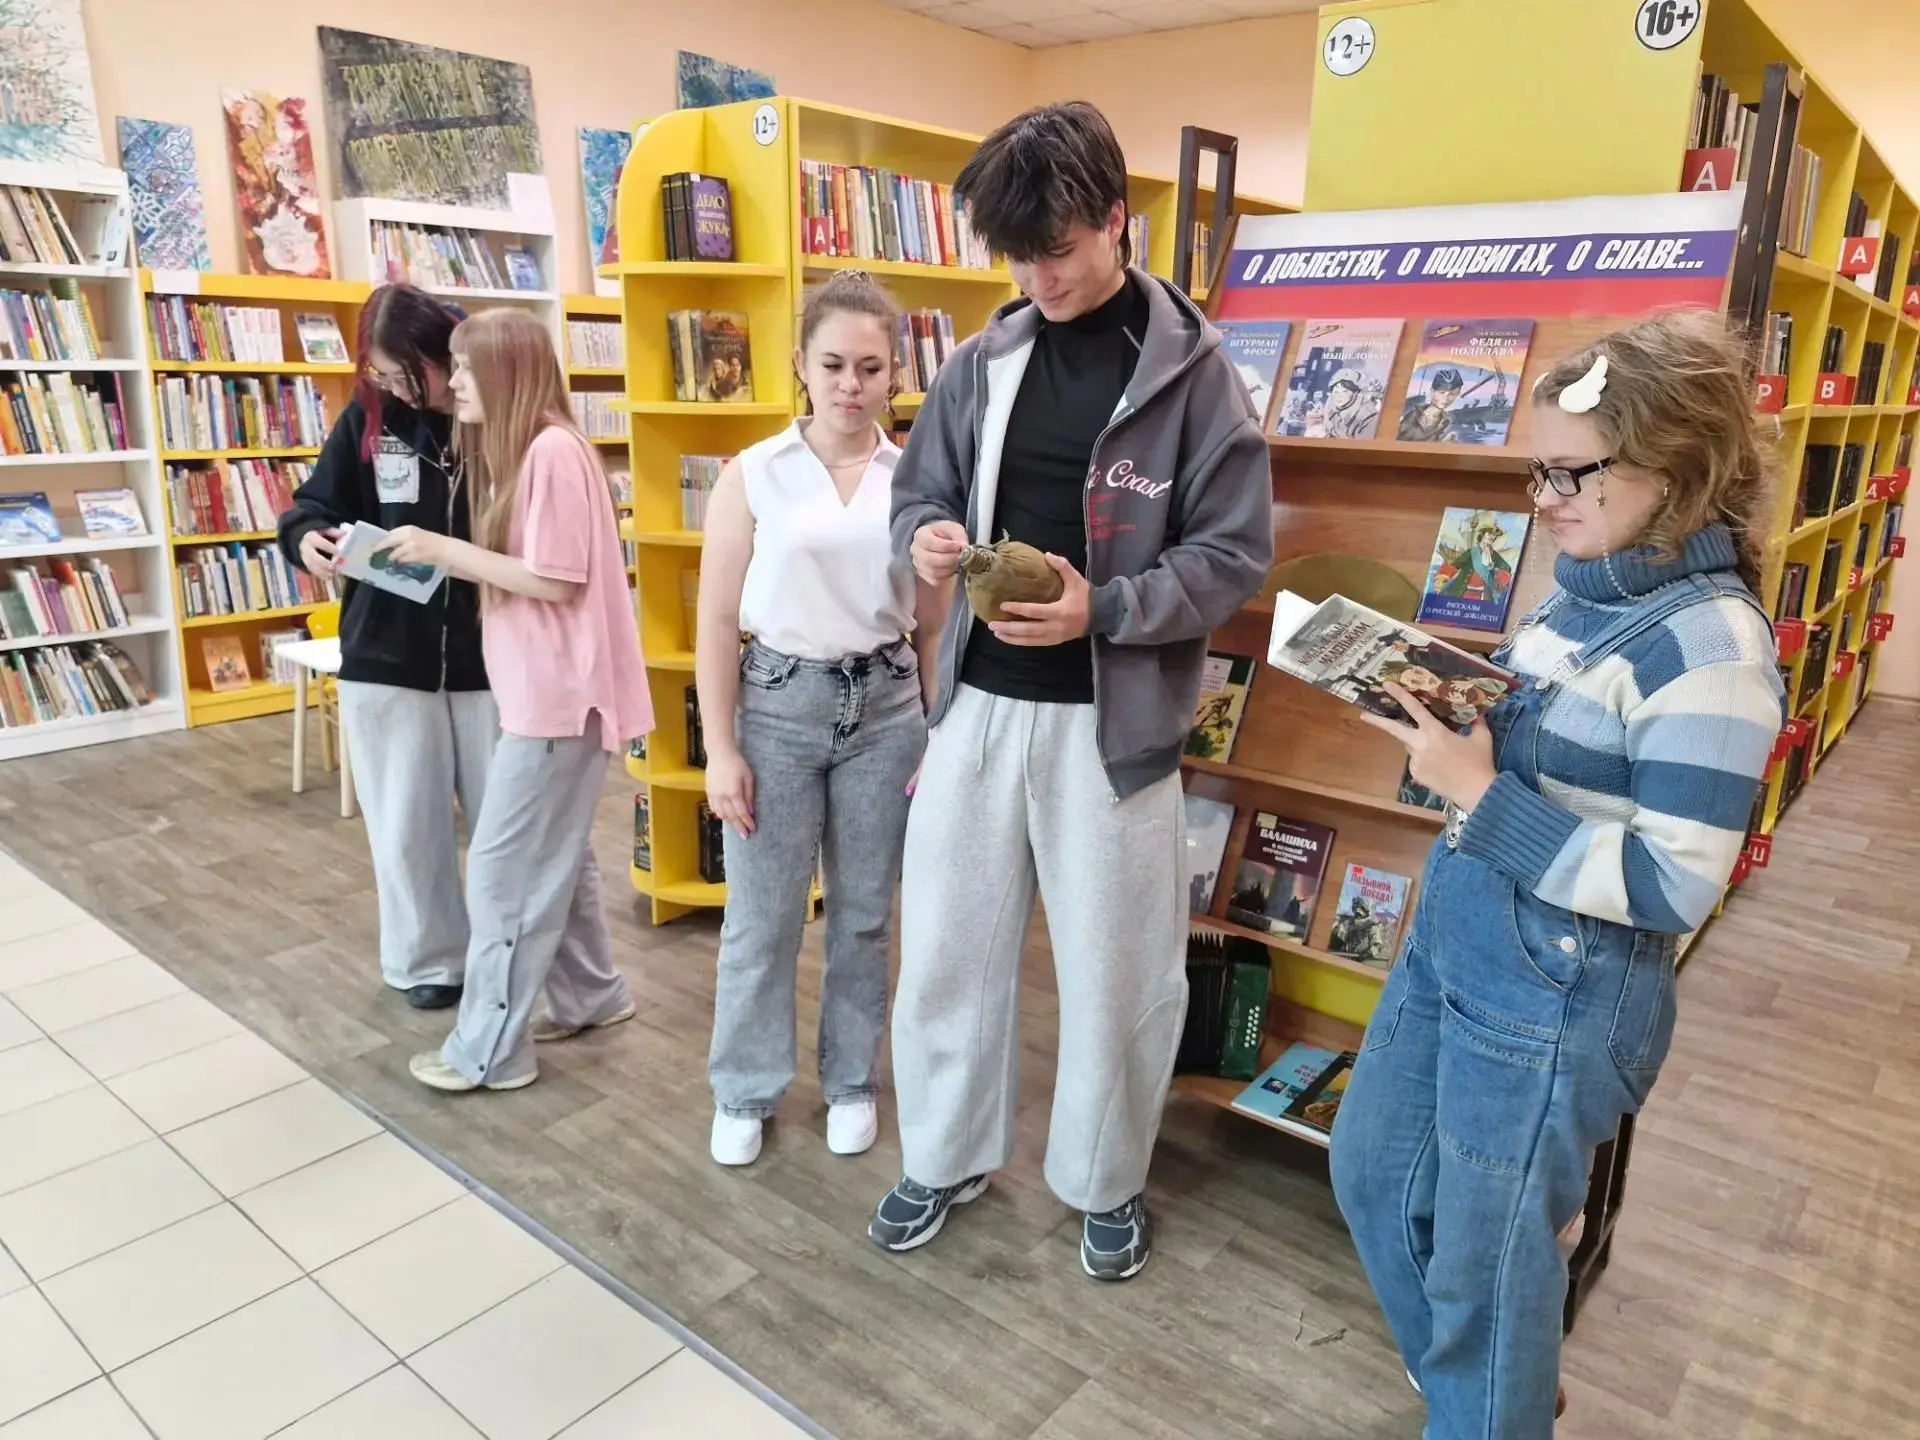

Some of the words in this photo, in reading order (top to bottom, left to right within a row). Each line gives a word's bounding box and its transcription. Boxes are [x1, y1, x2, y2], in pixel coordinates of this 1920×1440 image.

[1645, 0, 1694, 36] 16+
[1328, 34, 1371, 61] 12+
[755, 115, 777, 135] 12+
[1692, 160, 1718, 191] А
[696, 193, 725, 211] ДЕЛО
[698, 220, 729, 237] ЖУКА
[814, 224, 826, 245] А
[1242, 254, 1264, 281] О
[1396, 247, 1421, 276] О
[1421, 243, 1557, 279] ПОДВИГАХ,
[1566, 239, 1593, 271] О
[1849, 244, 1868, 264] А
[1229, 339, 1279, 348] ШТУРМАН
[1242, 347, 1276, 356] ФРОСЯ
[1450, 347, 1515, 356] ПОДПЛАВА
[1469, 337, 1502, 347] ФЕДЯ
[1106, 459, 1173, 499] Coast
[1446, 601, 1481, 612] РАССКАЗЫ
[1260, 828, 1318, 852] БАЛАШИХА
